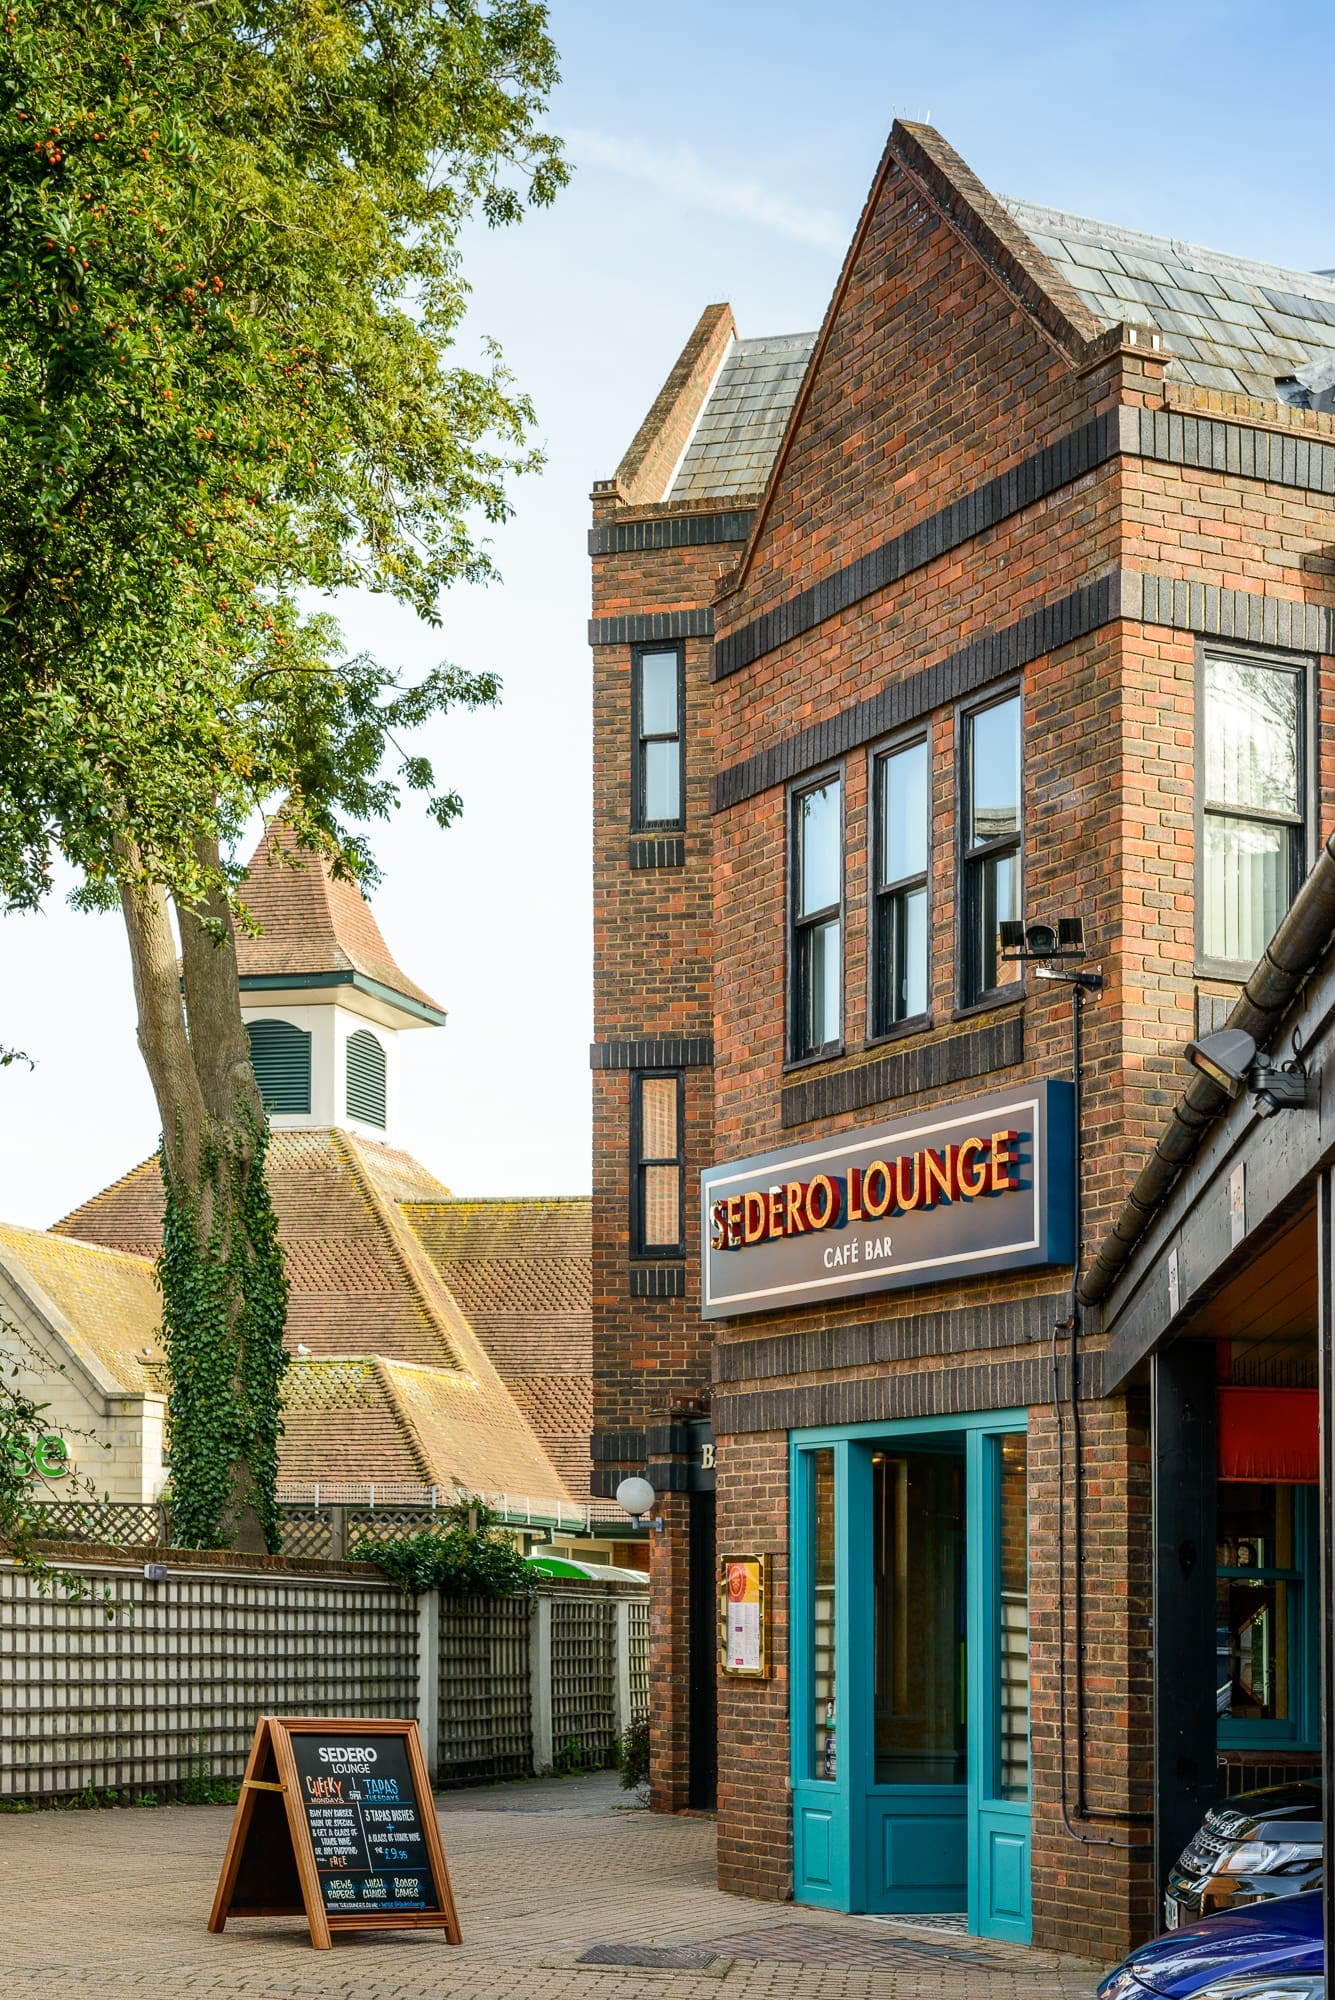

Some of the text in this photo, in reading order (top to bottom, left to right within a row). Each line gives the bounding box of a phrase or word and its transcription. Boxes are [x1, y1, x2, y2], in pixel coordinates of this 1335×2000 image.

[710, 1130, 1018, 1250] SEDERO LOUNGE
[823, 1236, 893, 1268] CAFÉ BAR
[701, 1444, 716, 1469] B
[318, 1747, 378, 1762] SEDERO
[332, 1763, 371, 1774] LOUNGE
[306, 1776, 342, 1798] CHEEKY
[363, 1778, 399, 1795] TAPAS
[364, 1809, 415, 1821] 3 TAPAS DISHES
[333, 1819, 355, 1827] SPECIAL
[317, 1828, 327, 1837] GET
[328, 1829, 333, 1837] A
[329, 1855, 348, 1868] FREE
[330, 1879, 353, 1890] NEWS
[364, 1878, 384, 1888] HIGH
[394, 1877, 419, 1888] BOARD
[327, 1889, 355, 1899] PAPERS
[362, 1888, 387, 1899] CHAIRS
[394, 1887, 419, 1898] GAMES
